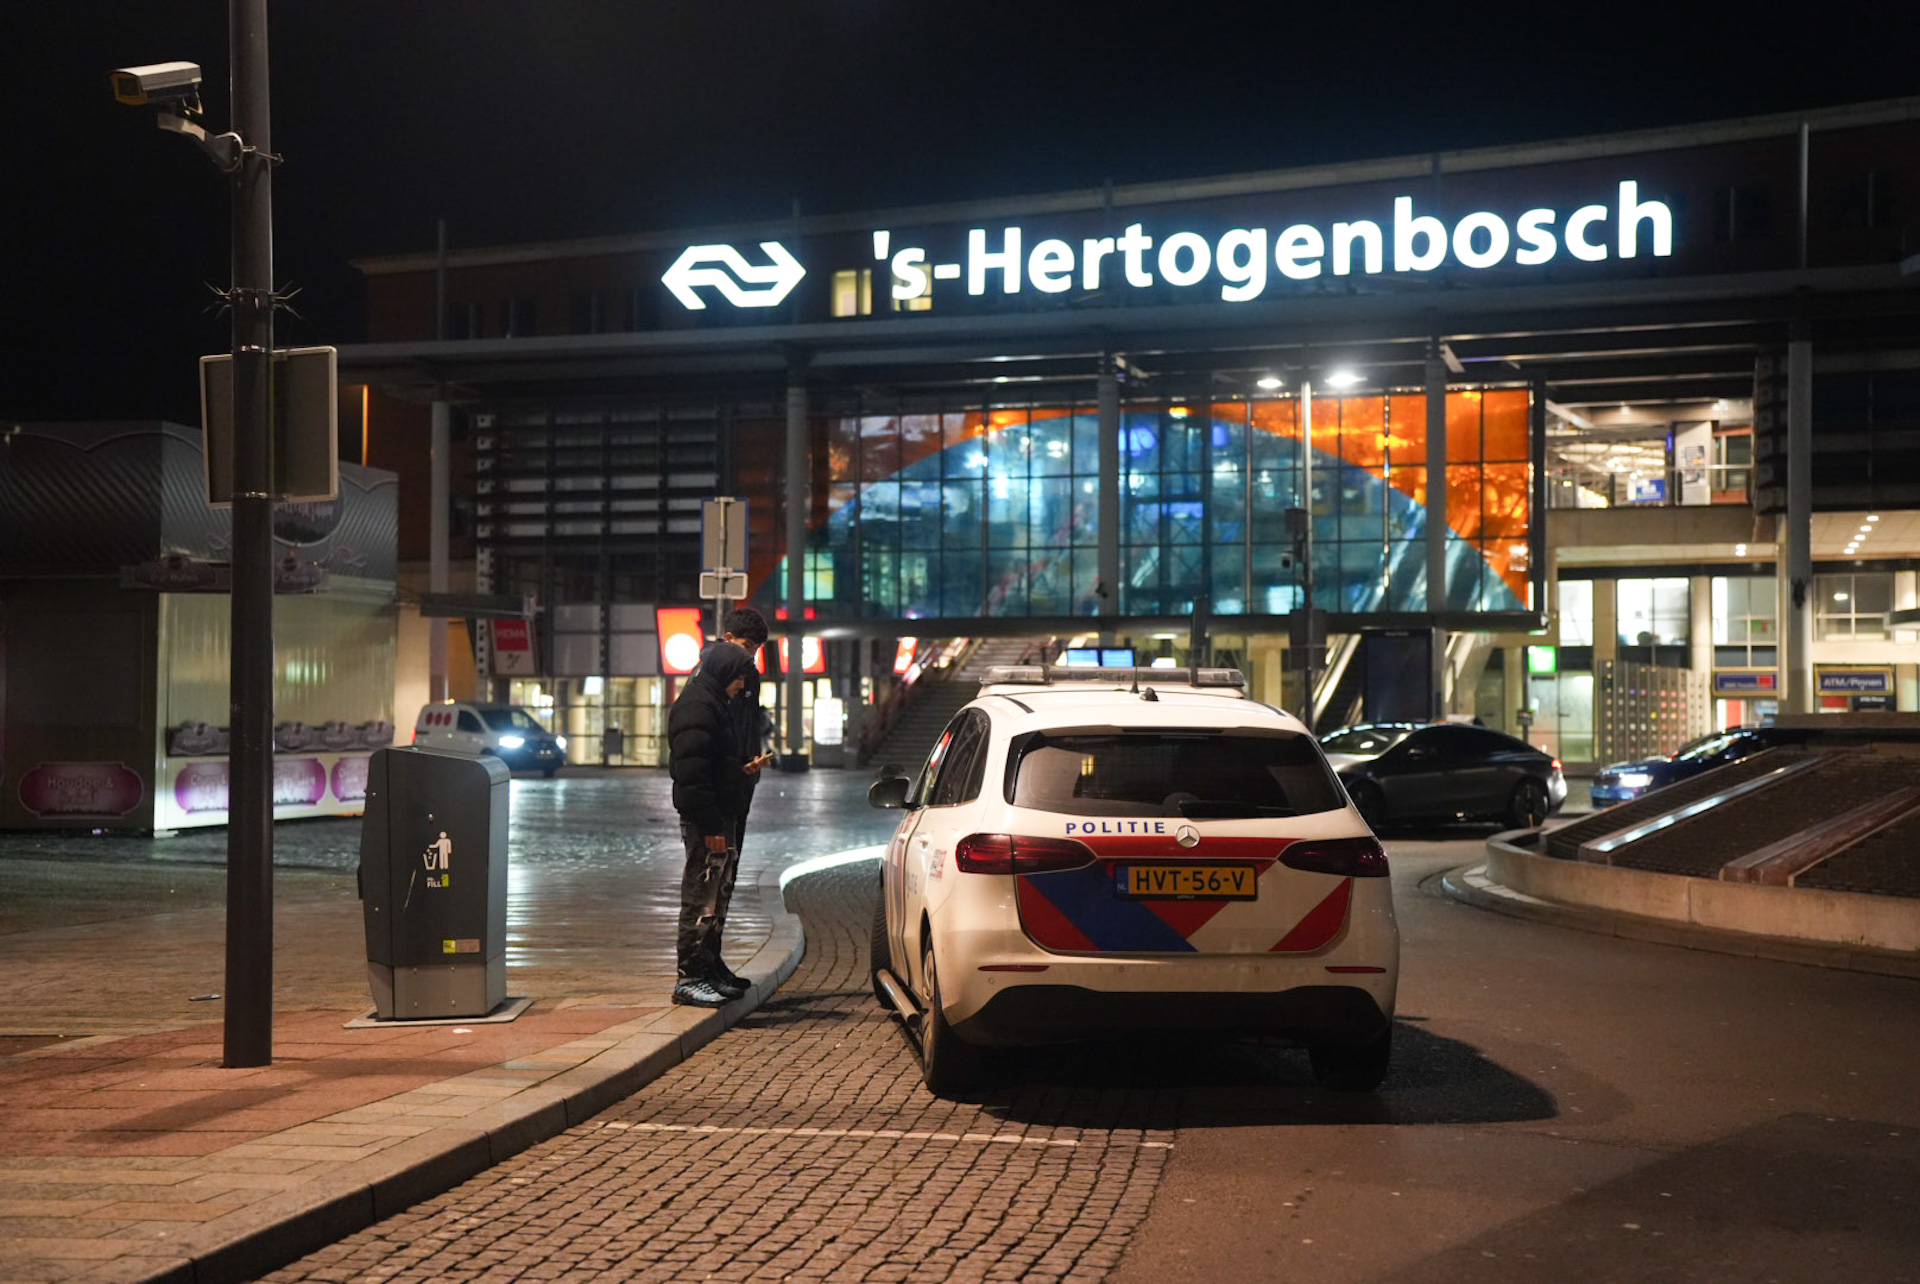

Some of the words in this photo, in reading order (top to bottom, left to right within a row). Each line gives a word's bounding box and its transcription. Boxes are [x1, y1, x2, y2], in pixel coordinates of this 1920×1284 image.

[872, 180, 1673, 302] 's-Hertogenbosch
[496, 628, 526, 639] HEMA
[1065, 822, 1166, 834] POLITIE
[1135, 869, 1245, 892] HVT-56-V
